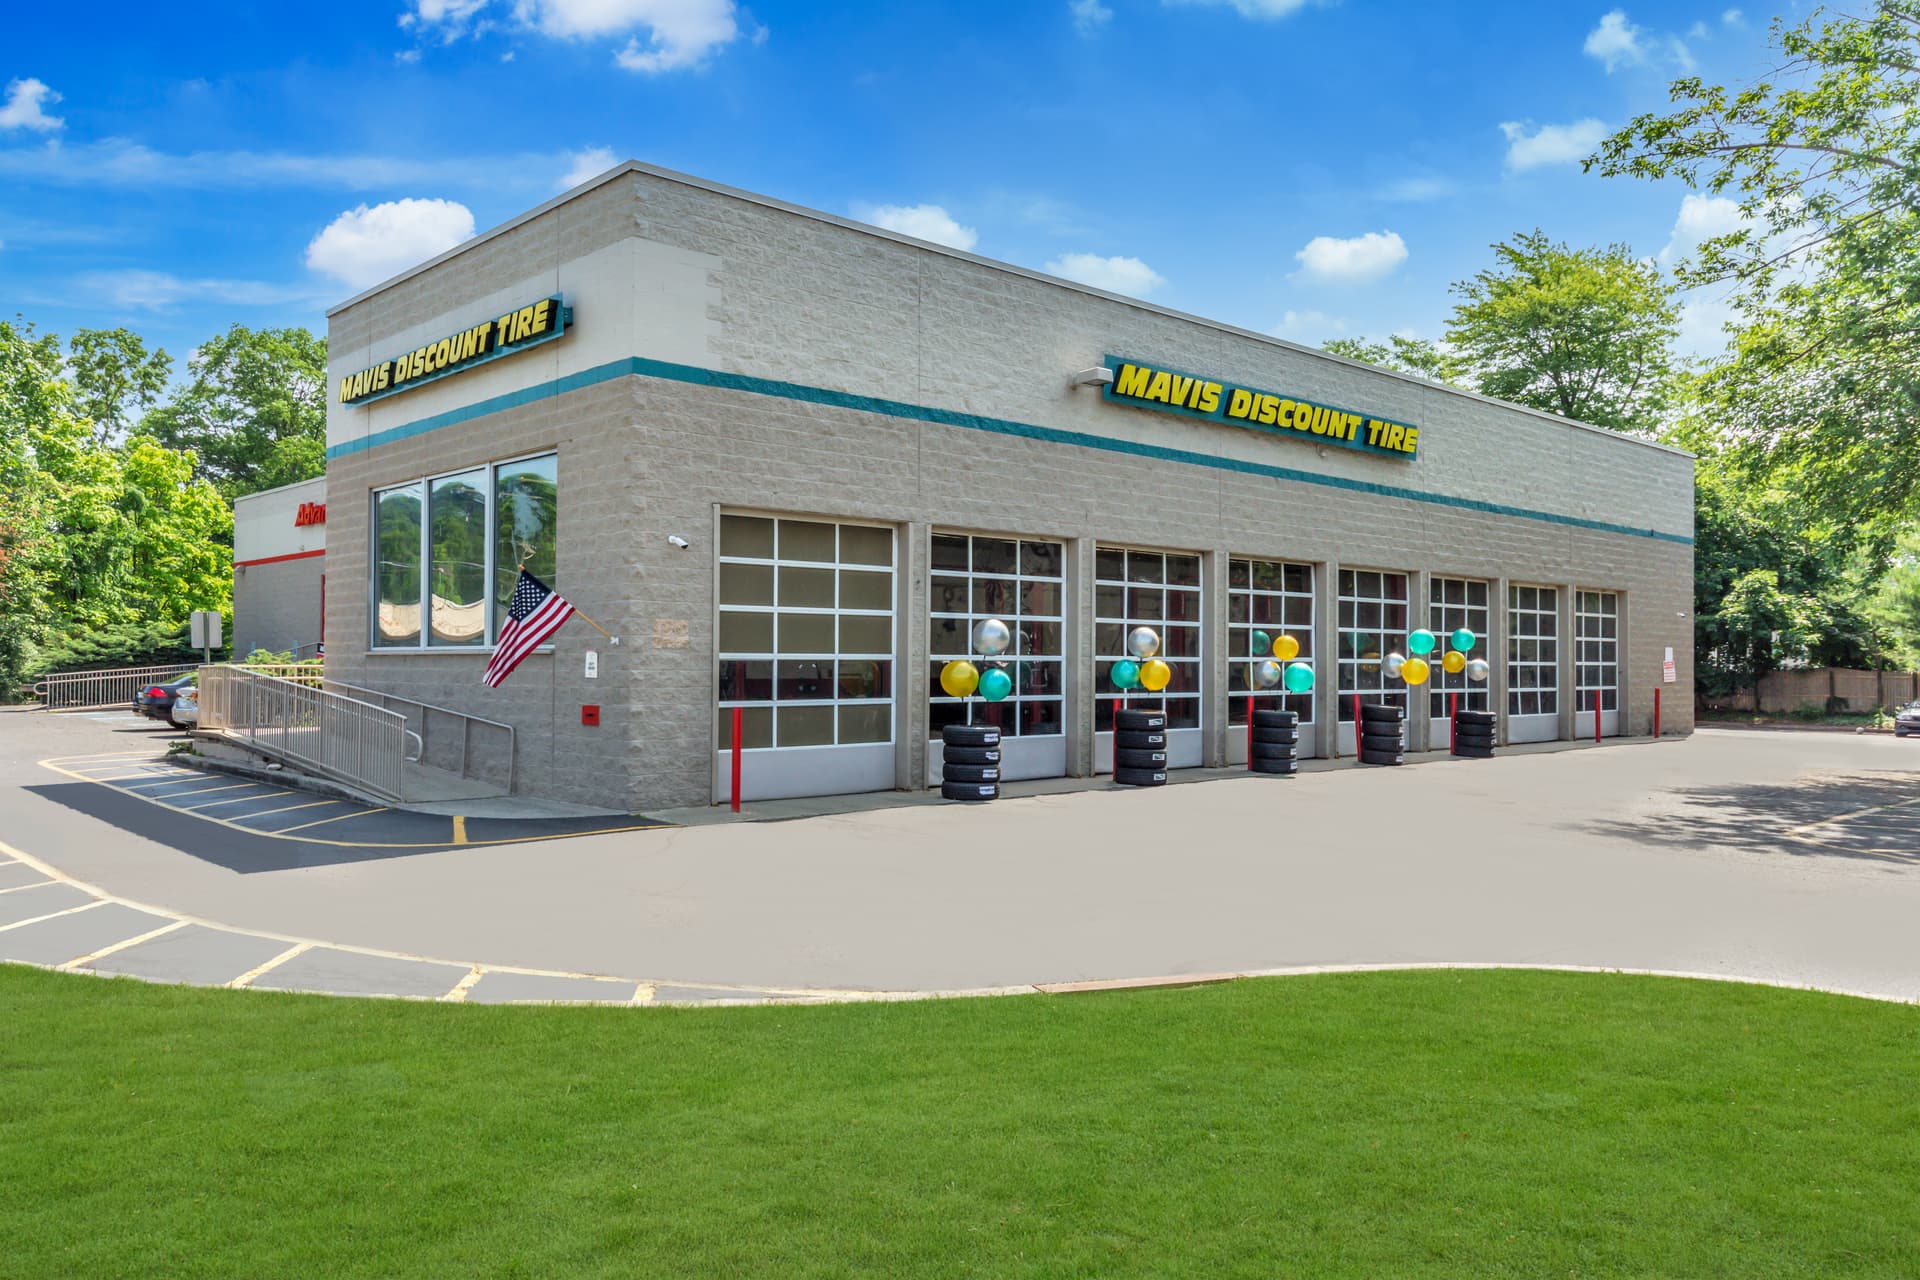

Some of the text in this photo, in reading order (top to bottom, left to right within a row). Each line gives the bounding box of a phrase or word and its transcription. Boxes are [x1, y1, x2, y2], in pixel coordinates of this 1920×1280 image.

[339, 298, 551, 402] MAVIS DISCOUNT TIRE
[1115, 363, 1419, 453] MAVIS DISCOUNT TIRE
